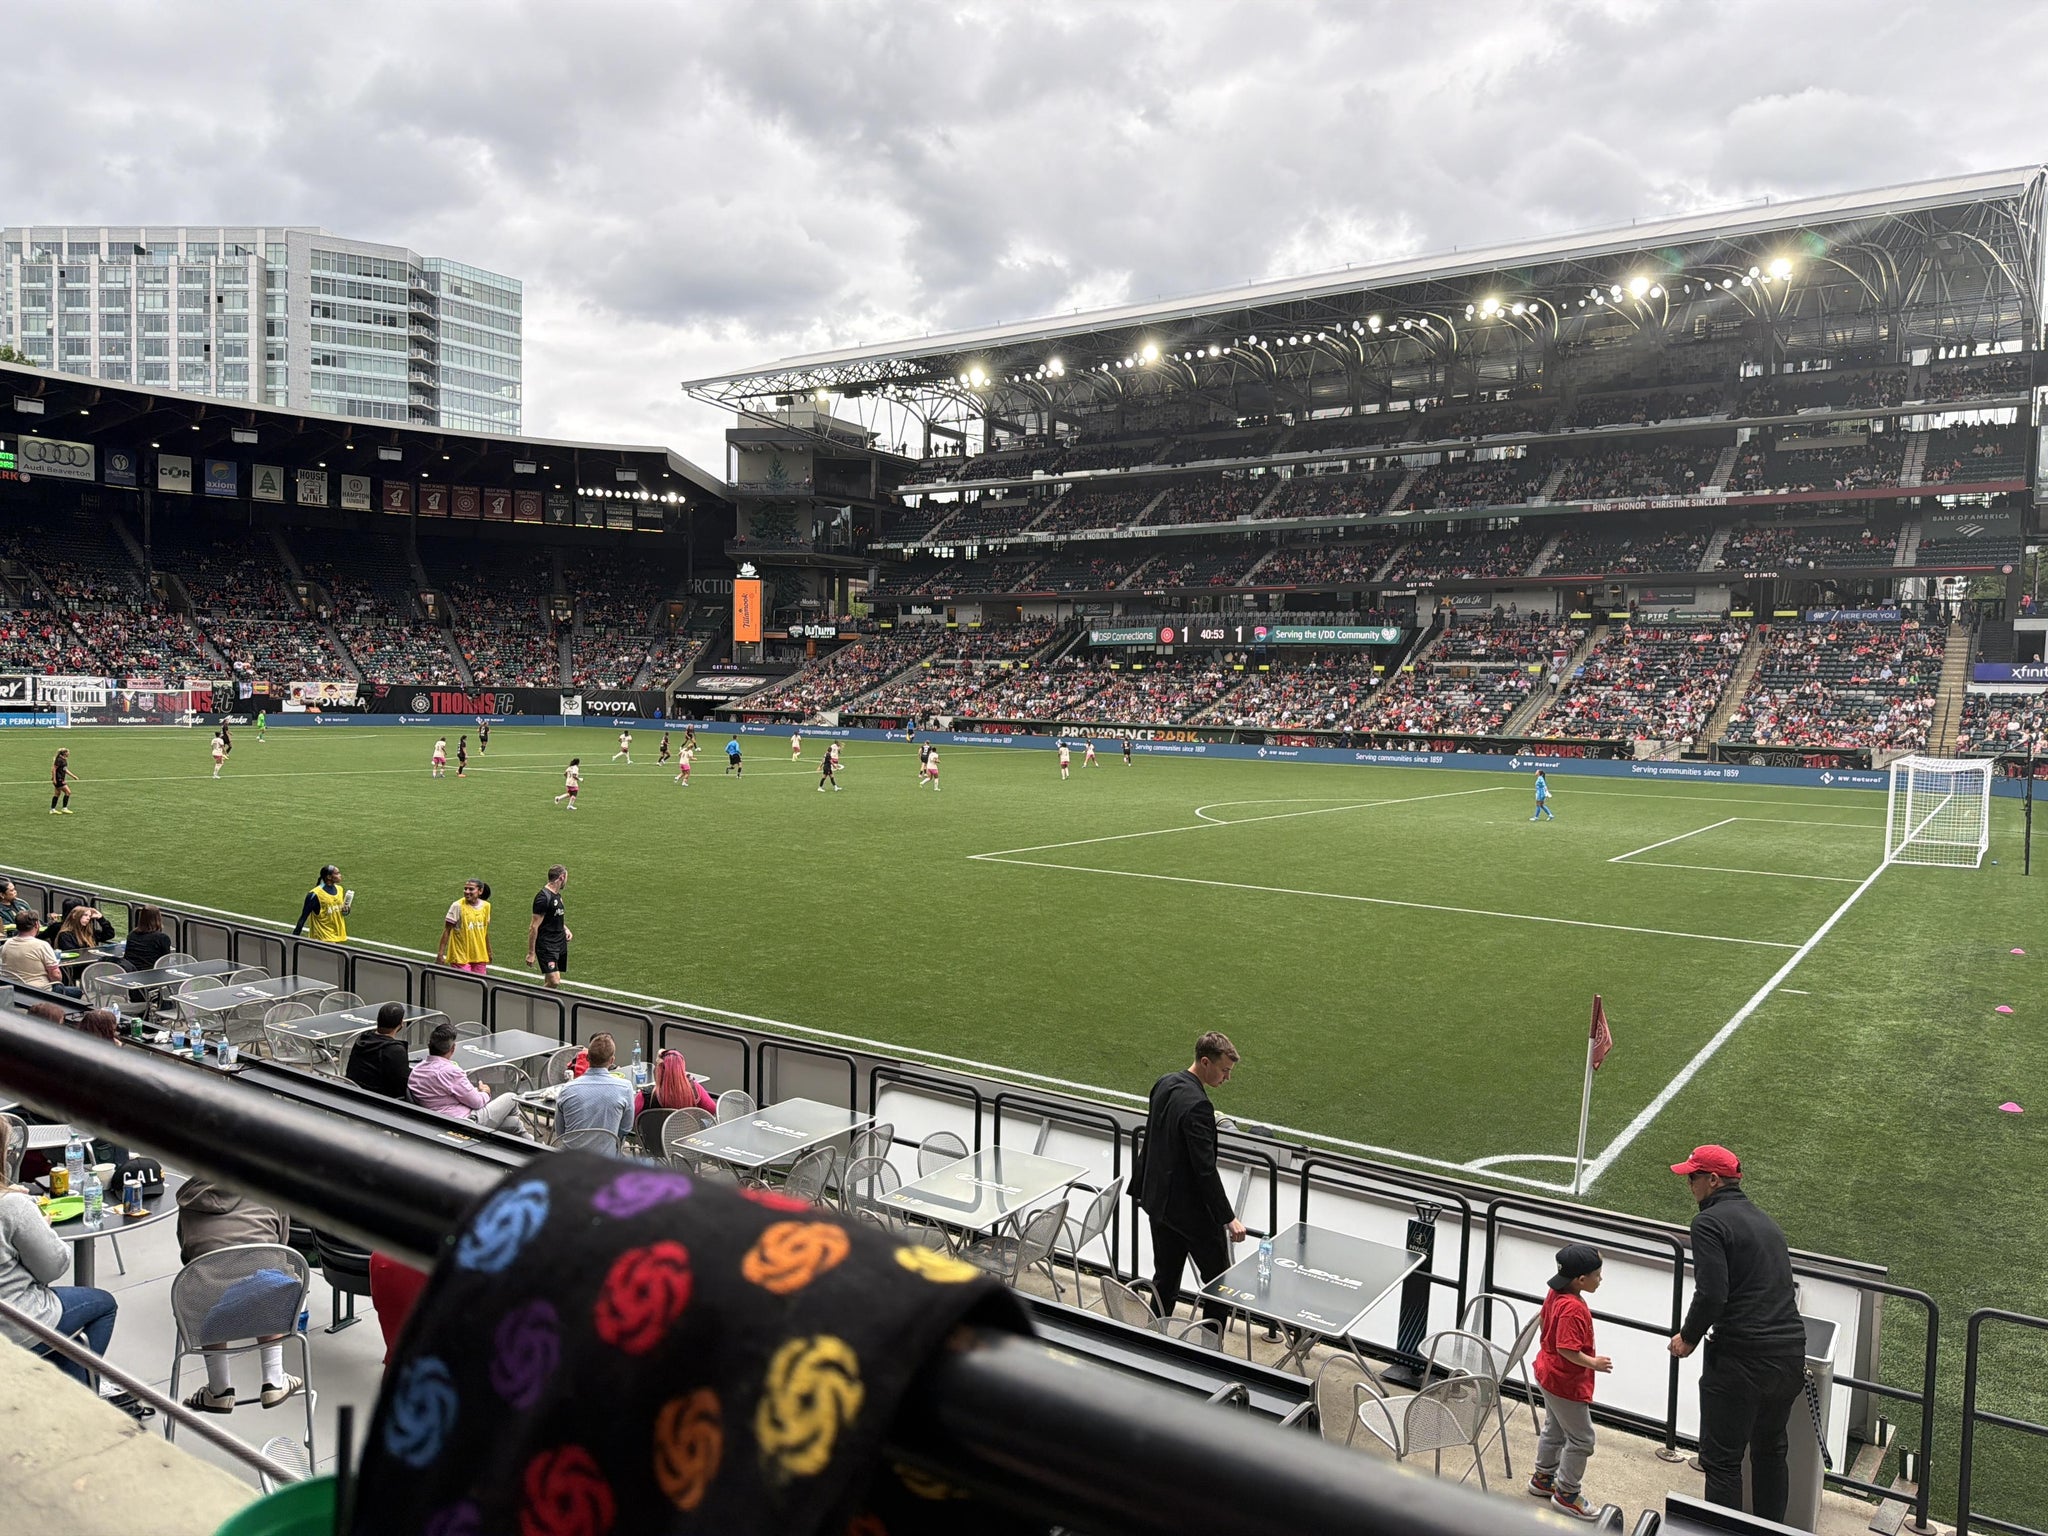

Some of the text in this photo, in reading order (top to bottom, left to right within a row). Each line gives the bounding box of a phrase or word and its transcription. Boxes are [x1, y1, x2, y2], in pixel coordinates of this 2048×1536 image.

[24, 463, 91, 477] Audi Beaverton
[299, 470, 326, 481] HOUSE
[206, 480, 236, 490] axiom
[302, 493, 323, 503] WINE
[1593, 504, 1611, 512] RING
[1618, 502, 1646, 511] HONOR
[1651, 499, 1690, 509] CHRISTINE
[1691, 497, 1727, 507] SINCLAIR
[907, 541, 921, 549] JOHN
[984, 537, 1003, 545] JIMMY
[1004, 536, 1028, 544] CONWAY
[1032, 535, 1054, 543] TIMBER
[1070, 533, 1086, 541] MICK
[1087, 532, 1109, 540] HOBAN
[1113, 531, 1132, 539] DIEGO
[1134, 529, 1158, 538] VALERI
[741, 593, 750, 629] Tillamook
[911, 605, 932, 615] Modelo
[1098, 630, 1153, 641] DSP Connections
[1181, 626, 1188, 643] 1
[1200, 629, 1225, 640] 40:53
[1235, 626, 1243, 643] 1
[1276, 630, 1380, 641] Serving the I/DD Community
[430, 692, 514, 715] THORNS FC
[586, 701, 637, 712] TOYOTA
[219, 715, 248, 724] Alaska
[1062, 727, 1198, 742] PROVIDENCE PARK
[1135, 743, 1152, 751] Serving
[1356, 753, 1443, 764] Serving communities since 1859
[1771, 752, 1801, 767] EST
[1632, 765, 1739, 777] Serving communities since 1859
[123, 1168, 158, 1184] CAL
[1293, 1269, 1358, 1290] EXPERIENCE AMAZING
[1298, 1265, 1363, 1287] LEXUS
[1217, 1284, 1234, 1295] T1
[1305, 1315, 1336, 1326] Portland
